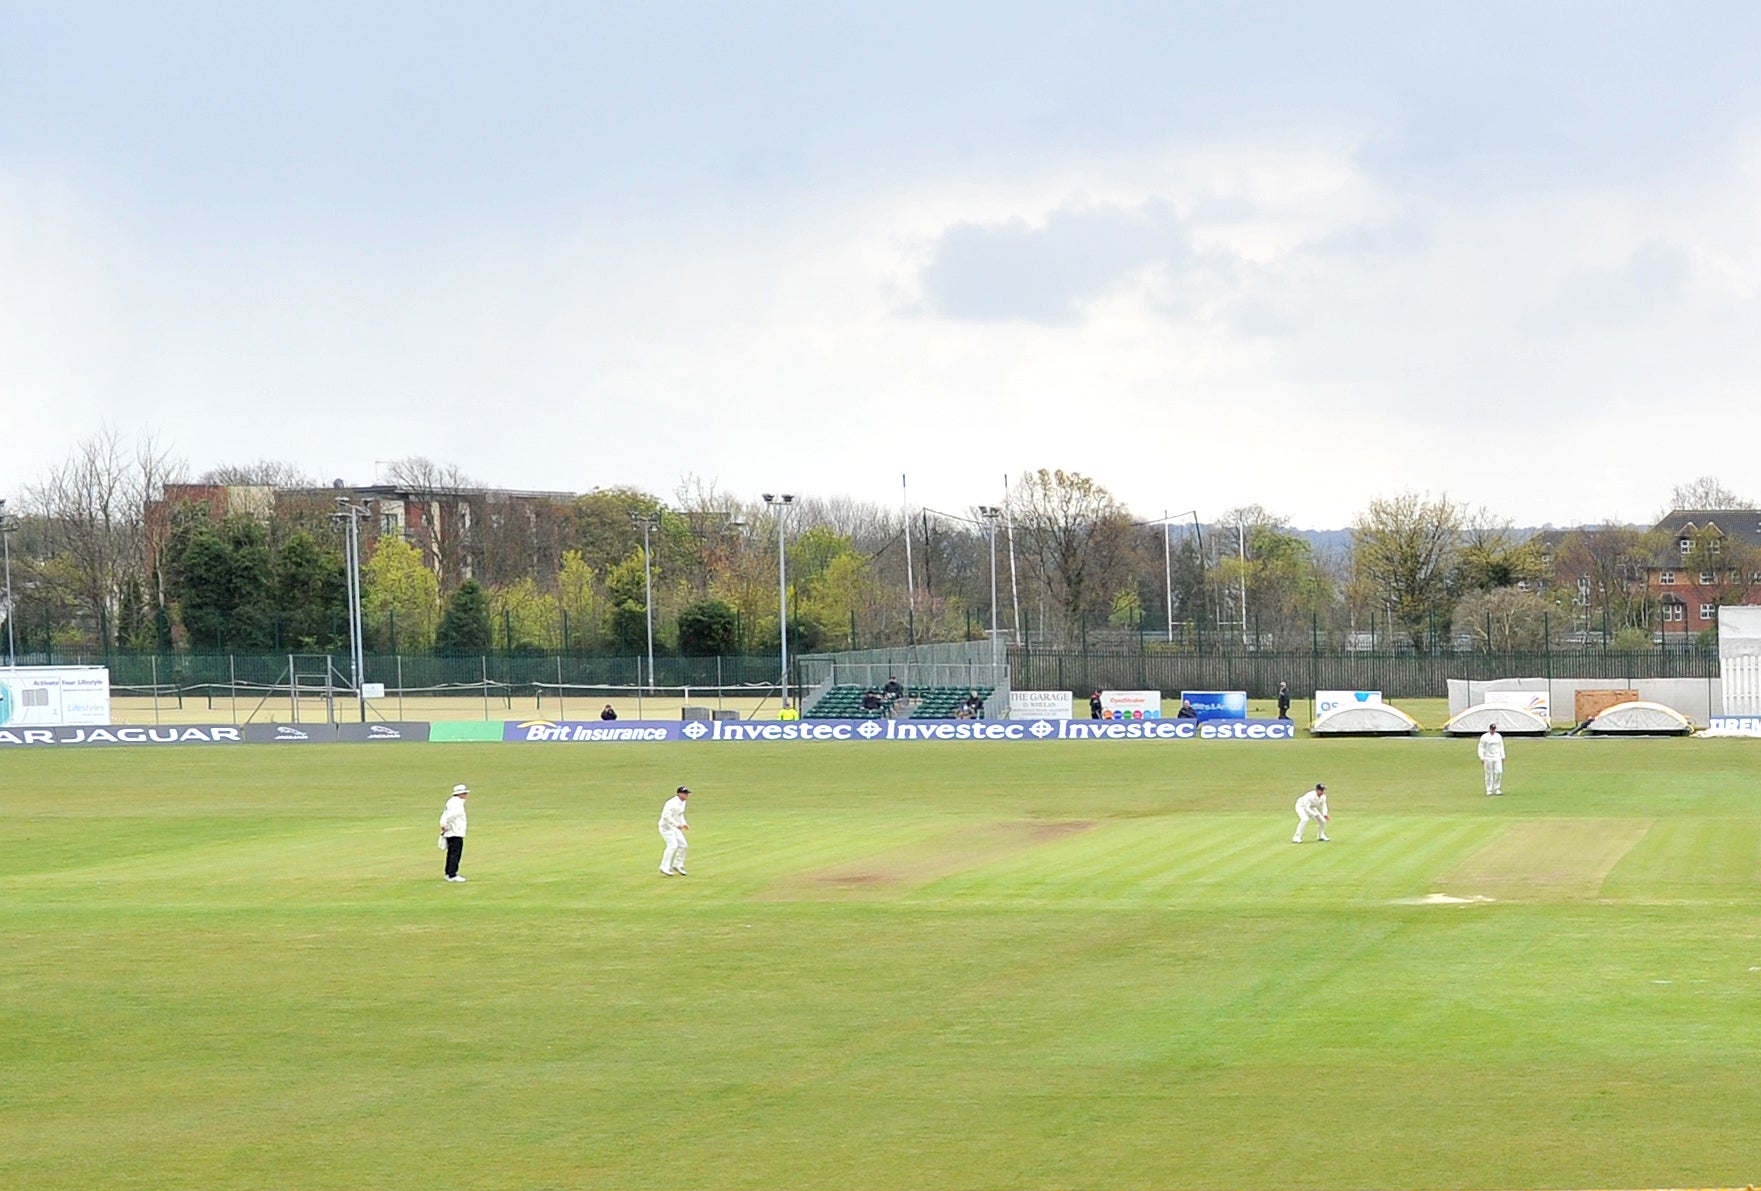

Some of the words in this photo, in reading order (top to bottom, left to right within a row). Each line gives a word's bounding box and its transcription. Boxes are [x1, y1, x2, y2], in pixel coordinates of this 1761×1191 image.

[1011, 692, 1028, 701] THE
[1029, 692, 1069, 701] GARAGE
[60, 727, 241, 744] JAGUAR
[526, 725, 570, 741] Brit
[571, 725, 667, 741] Insurance
[712, 720, 852, 740] Investec
[886, 720, 1024, 740] Investec
[1058, 719, 1194, 739] Investec
[1201, 721, 1284, 739] estec
